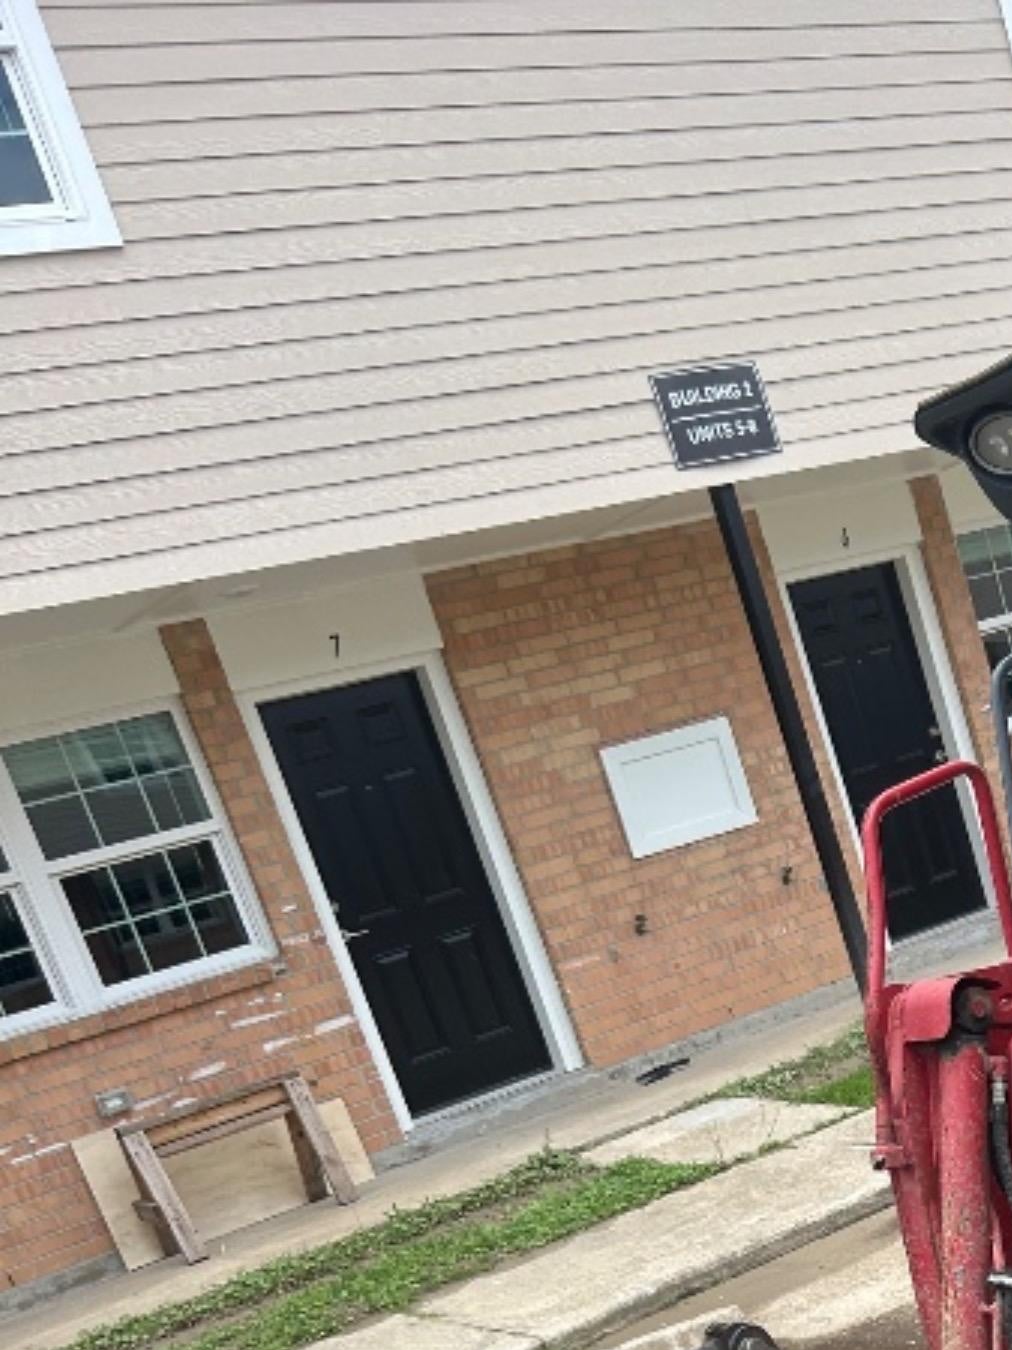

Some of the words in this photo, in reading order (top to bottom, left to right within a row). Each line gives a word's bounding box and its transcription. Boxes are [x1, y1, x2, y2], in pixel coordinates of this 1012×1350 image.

[668, 383, 742, 409] BUILDING
[686, 422, 734, 444] UNITS
[328, 633, 340, 658] 7
